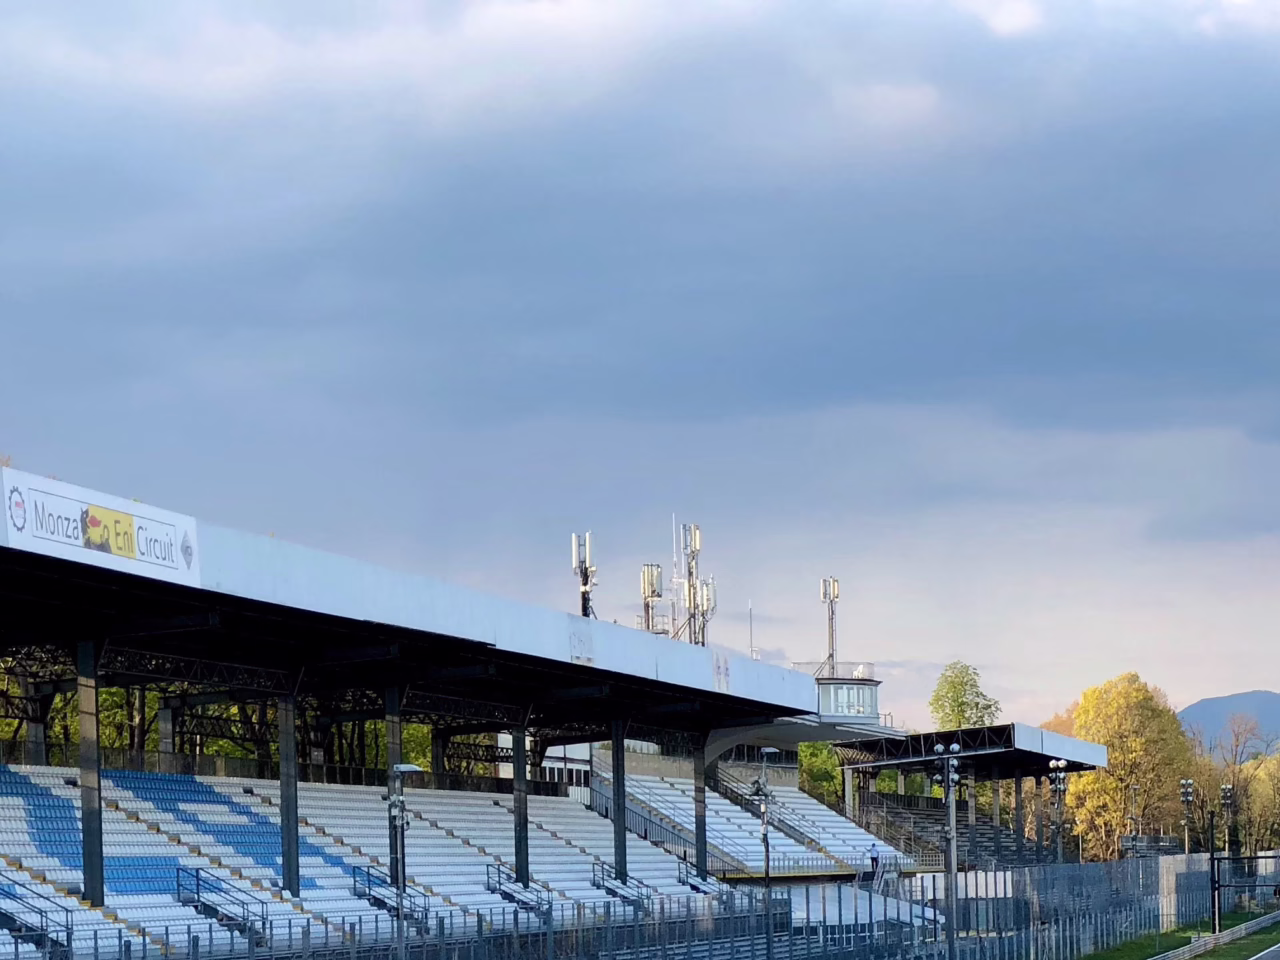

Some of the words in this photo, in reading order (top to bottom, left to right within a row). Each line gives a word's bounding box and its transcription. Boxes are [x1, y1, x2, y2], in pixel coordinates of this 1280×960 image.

[34, 499, 80, 541] Monza
[114, 519, 135, 554] Eni
[136, 525, 175, 564] Circuit
